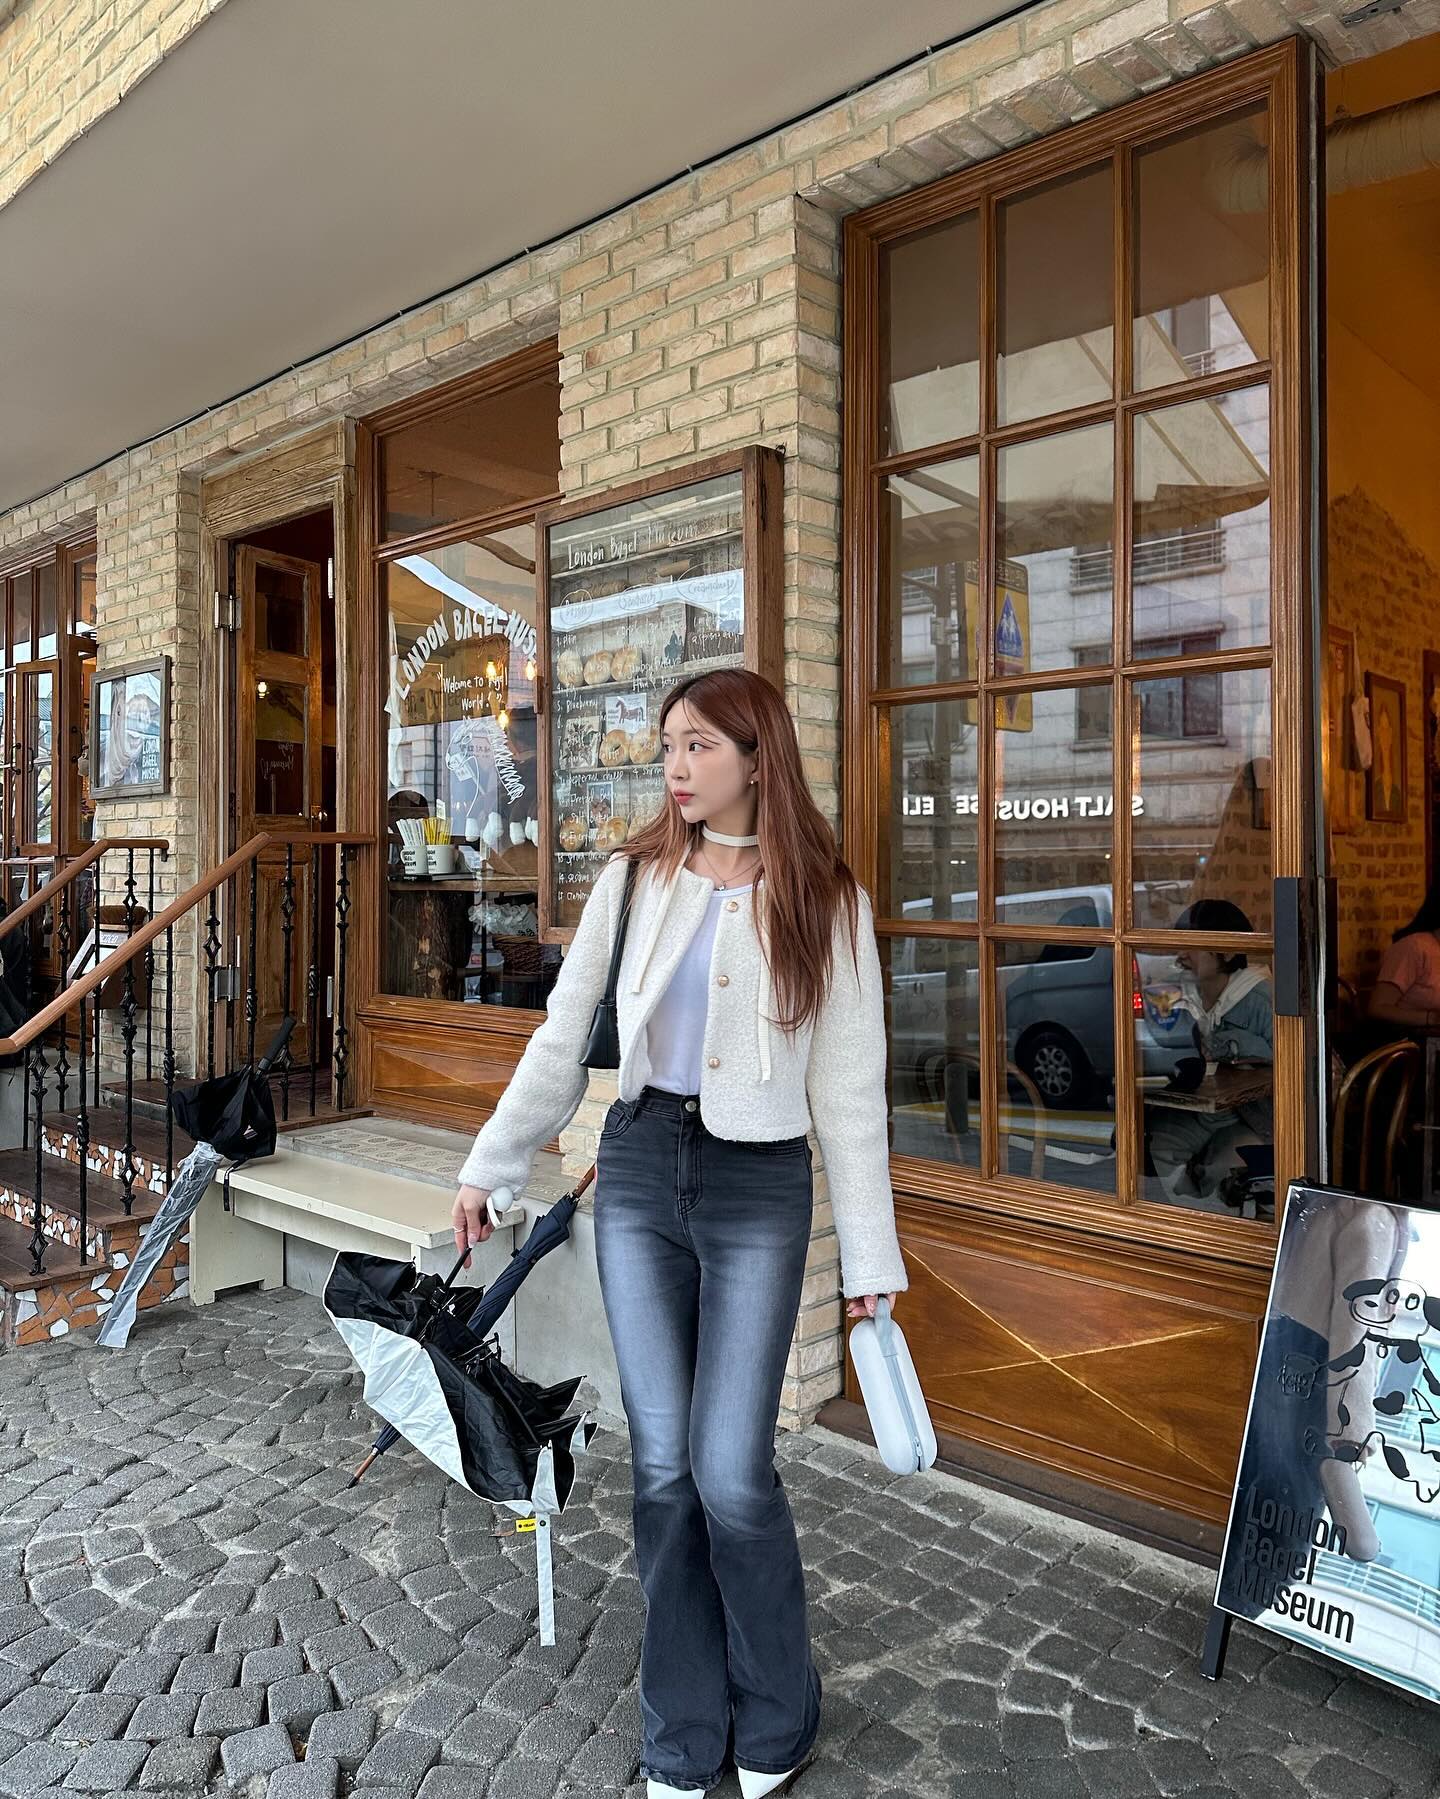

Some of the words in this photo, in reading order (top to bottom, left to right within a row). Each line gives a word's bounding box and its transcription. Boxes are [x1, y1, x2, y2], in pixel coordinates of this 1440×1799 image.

[568, 541, 604, 570] London
[611, 532, 637, 562] Bagel
[394, 614, 450, 700] LONDON
[453, 604, 507, 641] BAGEL
[1242, 1521, 1318, 1585] Bagel
[1244, 1485, 1348, 1556] London
[1236, 1562, 1355, 1644] Museum
